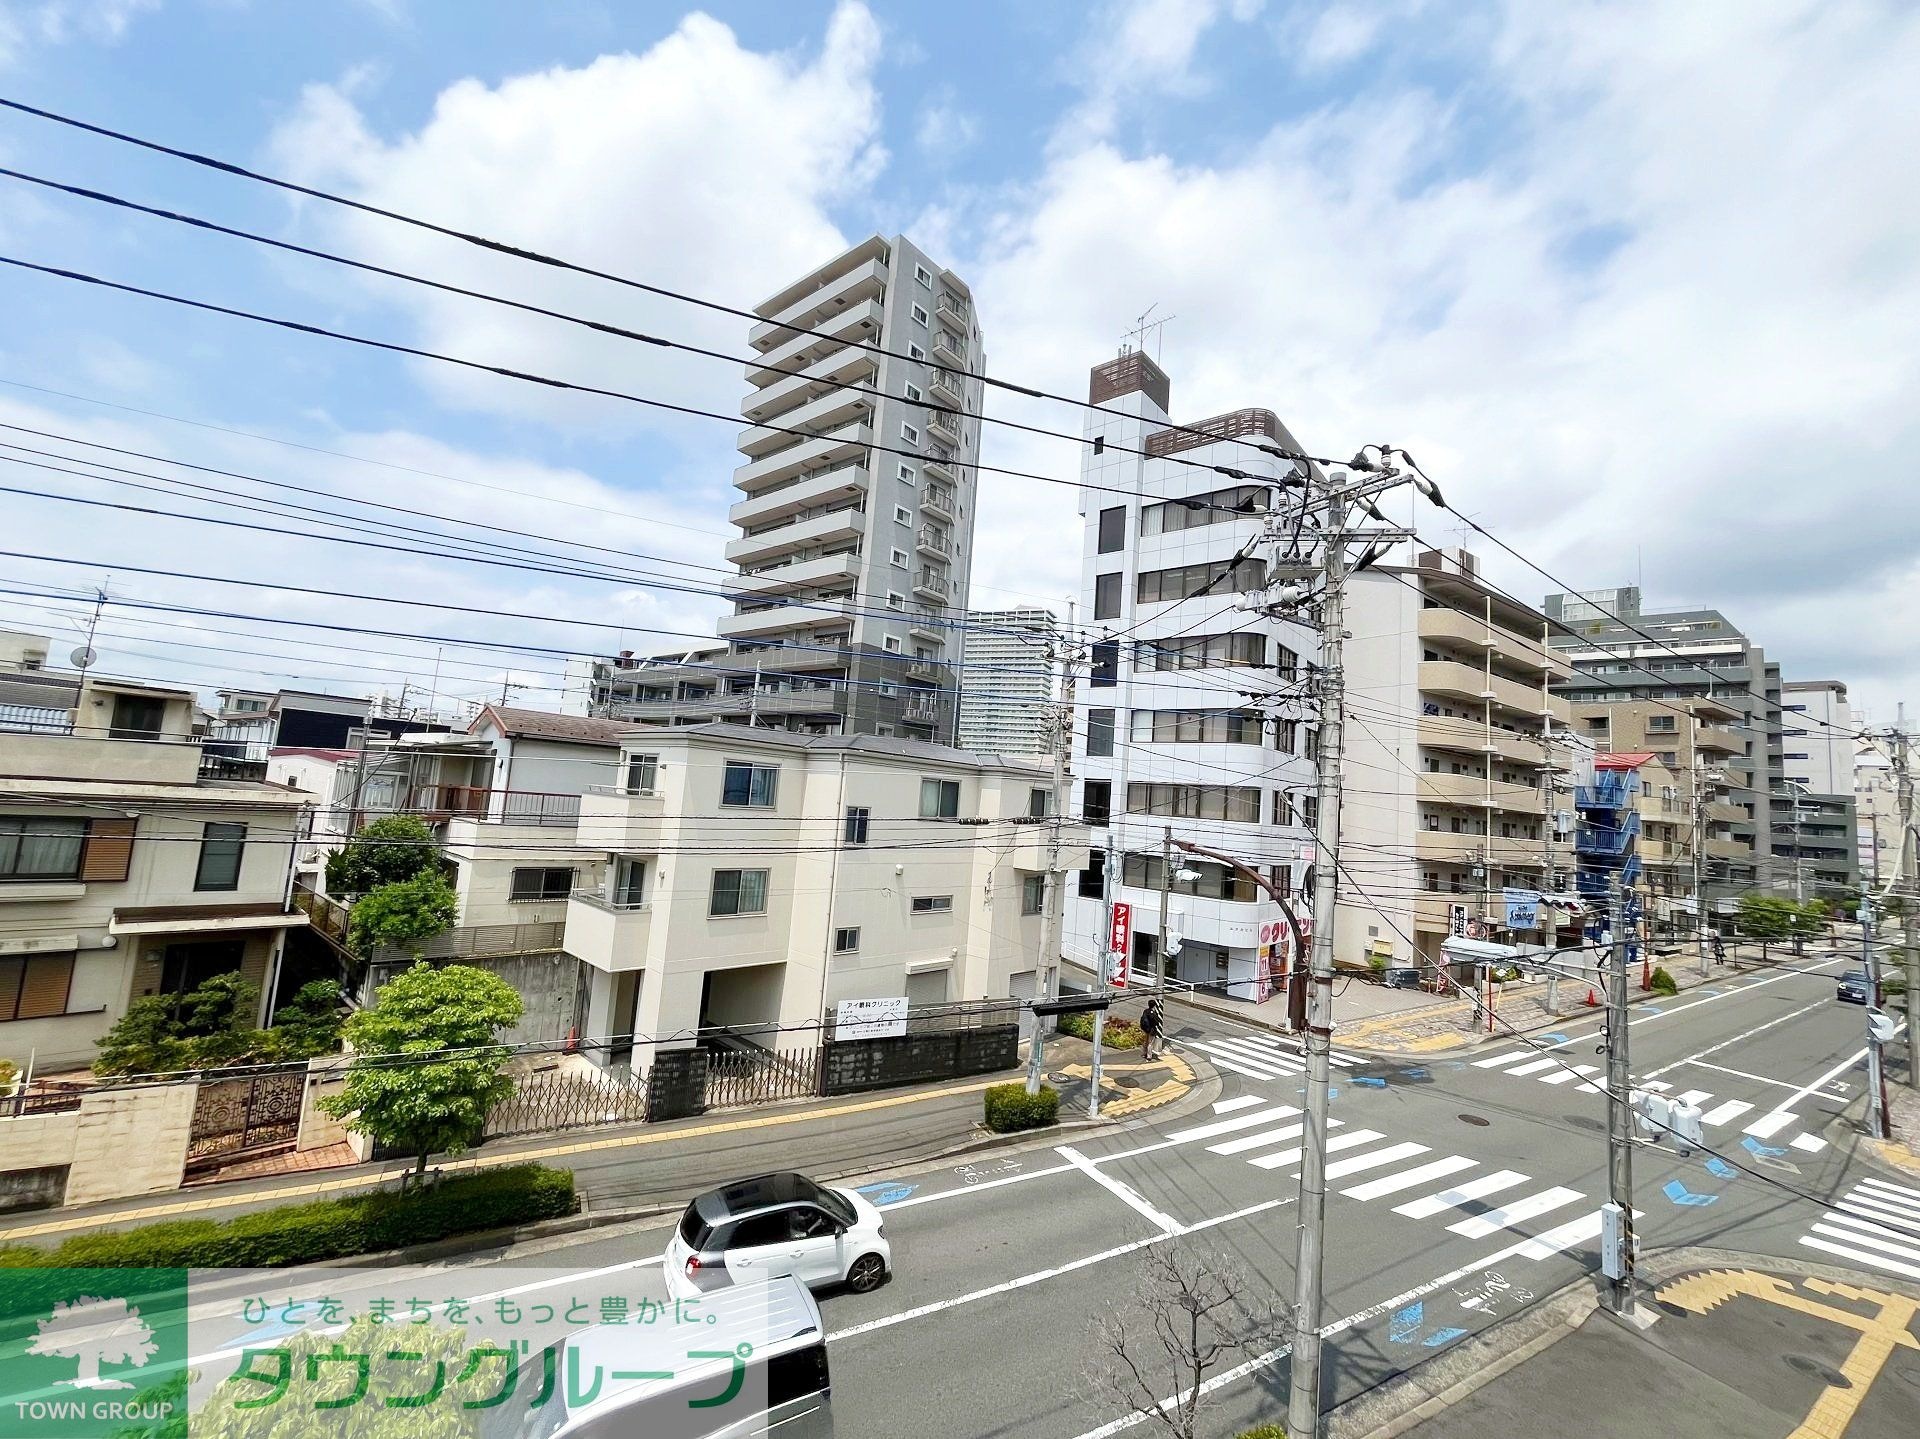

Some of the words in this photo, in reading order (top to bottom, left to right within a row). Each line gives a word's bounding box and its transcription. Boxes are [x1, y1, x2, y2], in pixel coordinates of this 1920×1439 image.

[847, 999, 901, 1009] アイ眼科クリニック
